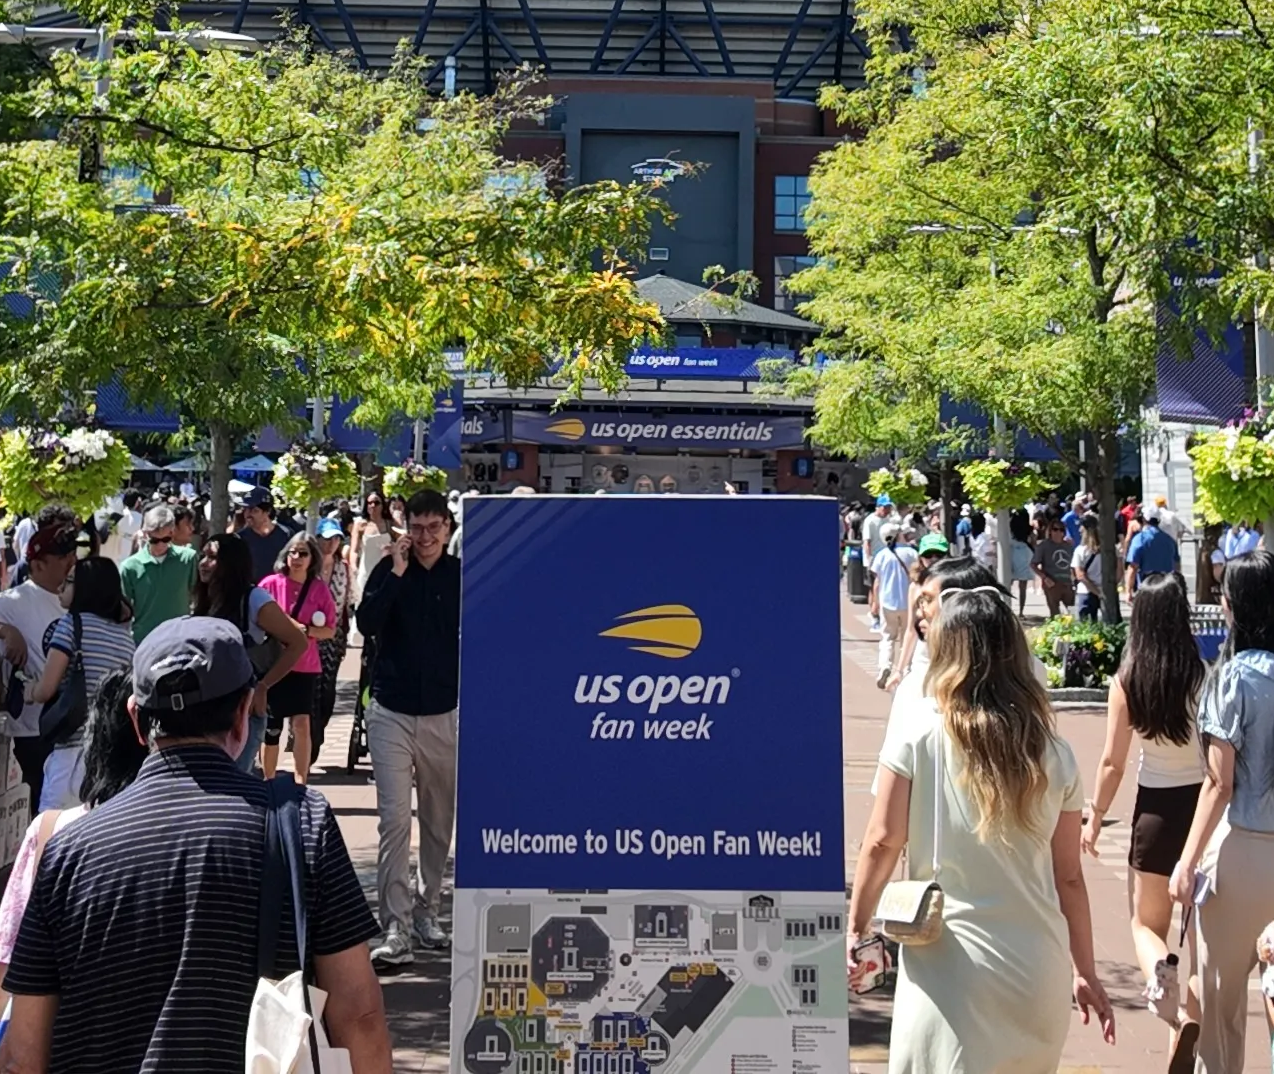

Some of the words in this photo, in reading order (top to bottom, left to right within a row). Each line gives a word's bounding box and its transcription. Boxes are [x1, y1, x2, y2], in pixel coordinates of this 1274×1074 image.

[630, 355, 646, 365] us
[647, 356, 680, 368] open
[698, 358, 718, 367] week
[591, 422, 615, 437] us
[616, 423, 666, 442] open
[671, 421, 774, 441] essentials
[574, 675, 623, 703] us
[627, 675, 731, 714] open
[590, 712, 635, 739] fan
[643, 713, 714, 740] week
[481, 829, 577, 854] Welcome
[584, 829, 608, 854] to
[615, 829, 644, 854] US
[651, 830, 706, 860] Open
[713, 830, 750, 856] Fan
[757, 831, 821, 857] Week!
